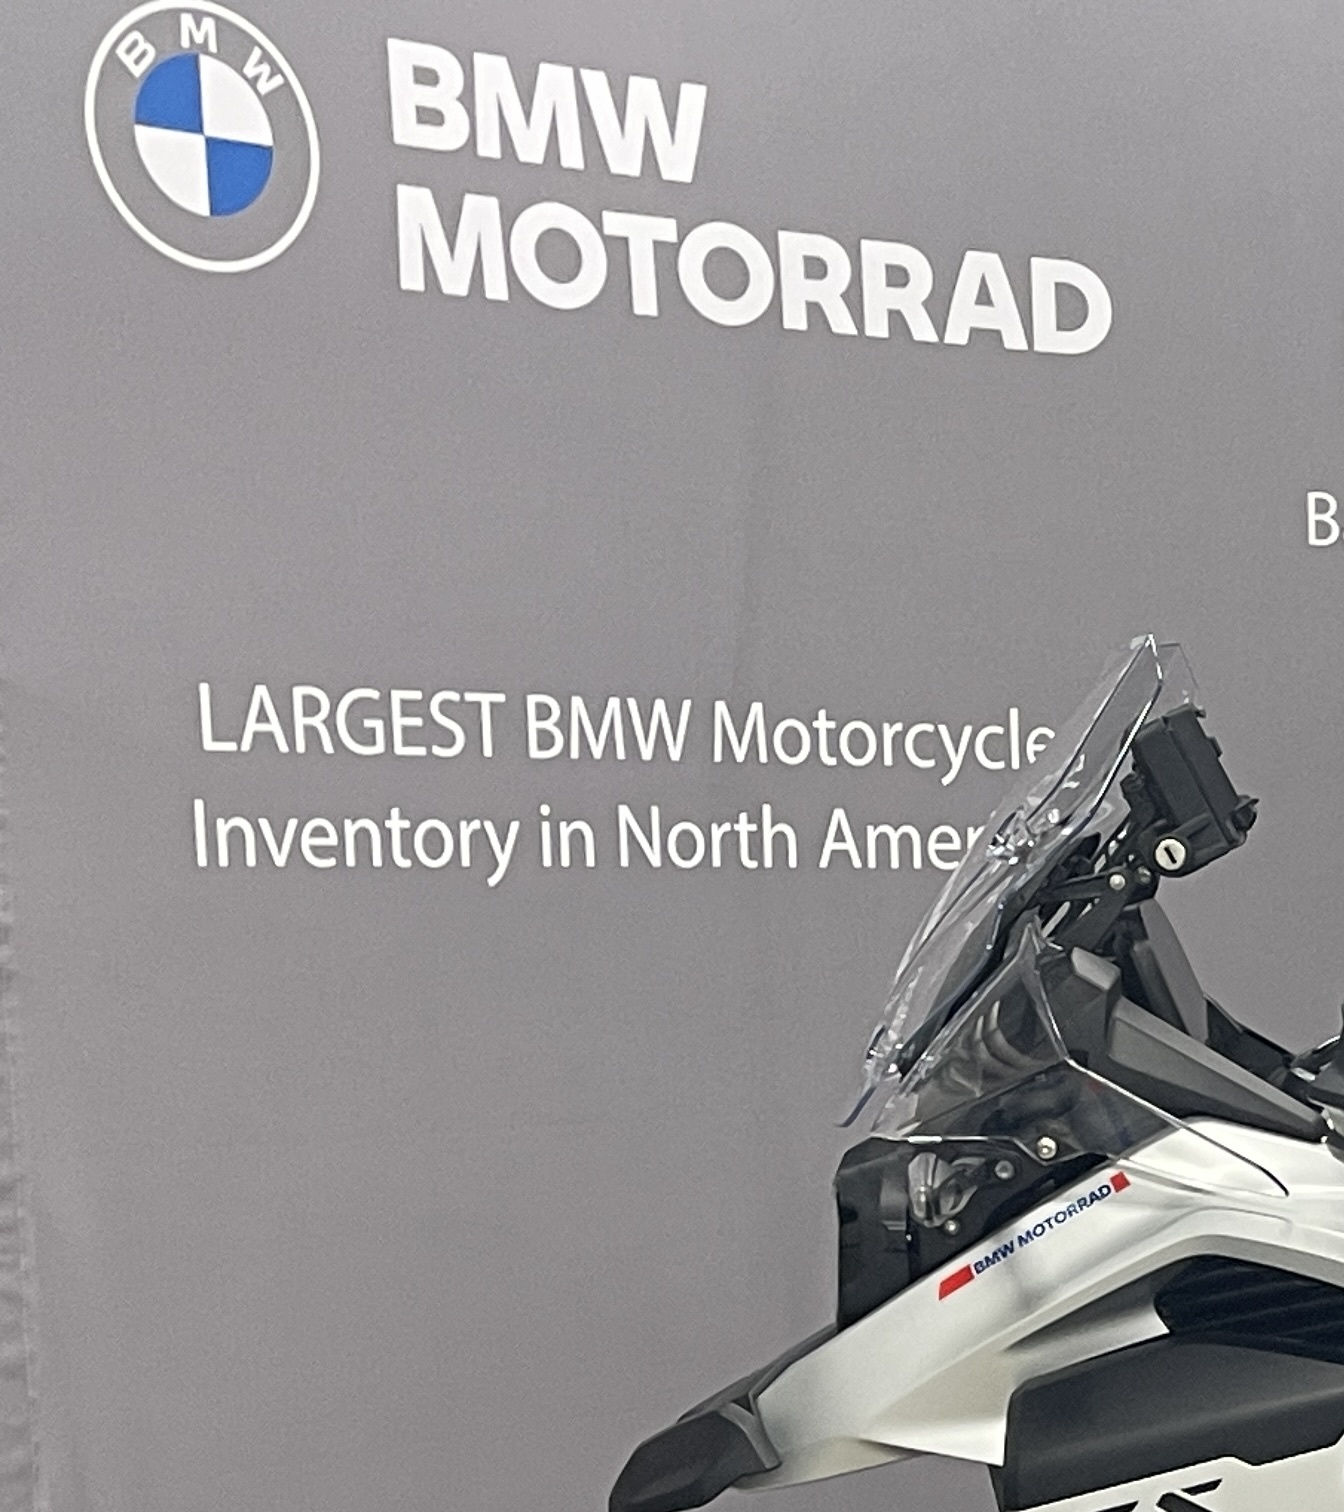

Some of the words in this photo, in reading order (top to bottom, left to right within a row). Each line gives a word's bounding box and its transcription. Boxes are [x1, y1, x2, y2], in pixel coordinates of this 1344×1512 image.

[115, 12, 285, 97] BMW
[387, 37, 708, 183] BMW
[396, 184, 1113, 355] MOTORRAD
[198, 682, 506, 758] LARGEST
[526, 694, 692, 762] BMW
[194, 798, 520, 887] Inventory
[540, 804, 595, 868] in
[618, 803, 797, 869] North
[973, 1240, 1015, 1275] BMW
[1017, 1184, 1112, 1249] MOTORRAD
